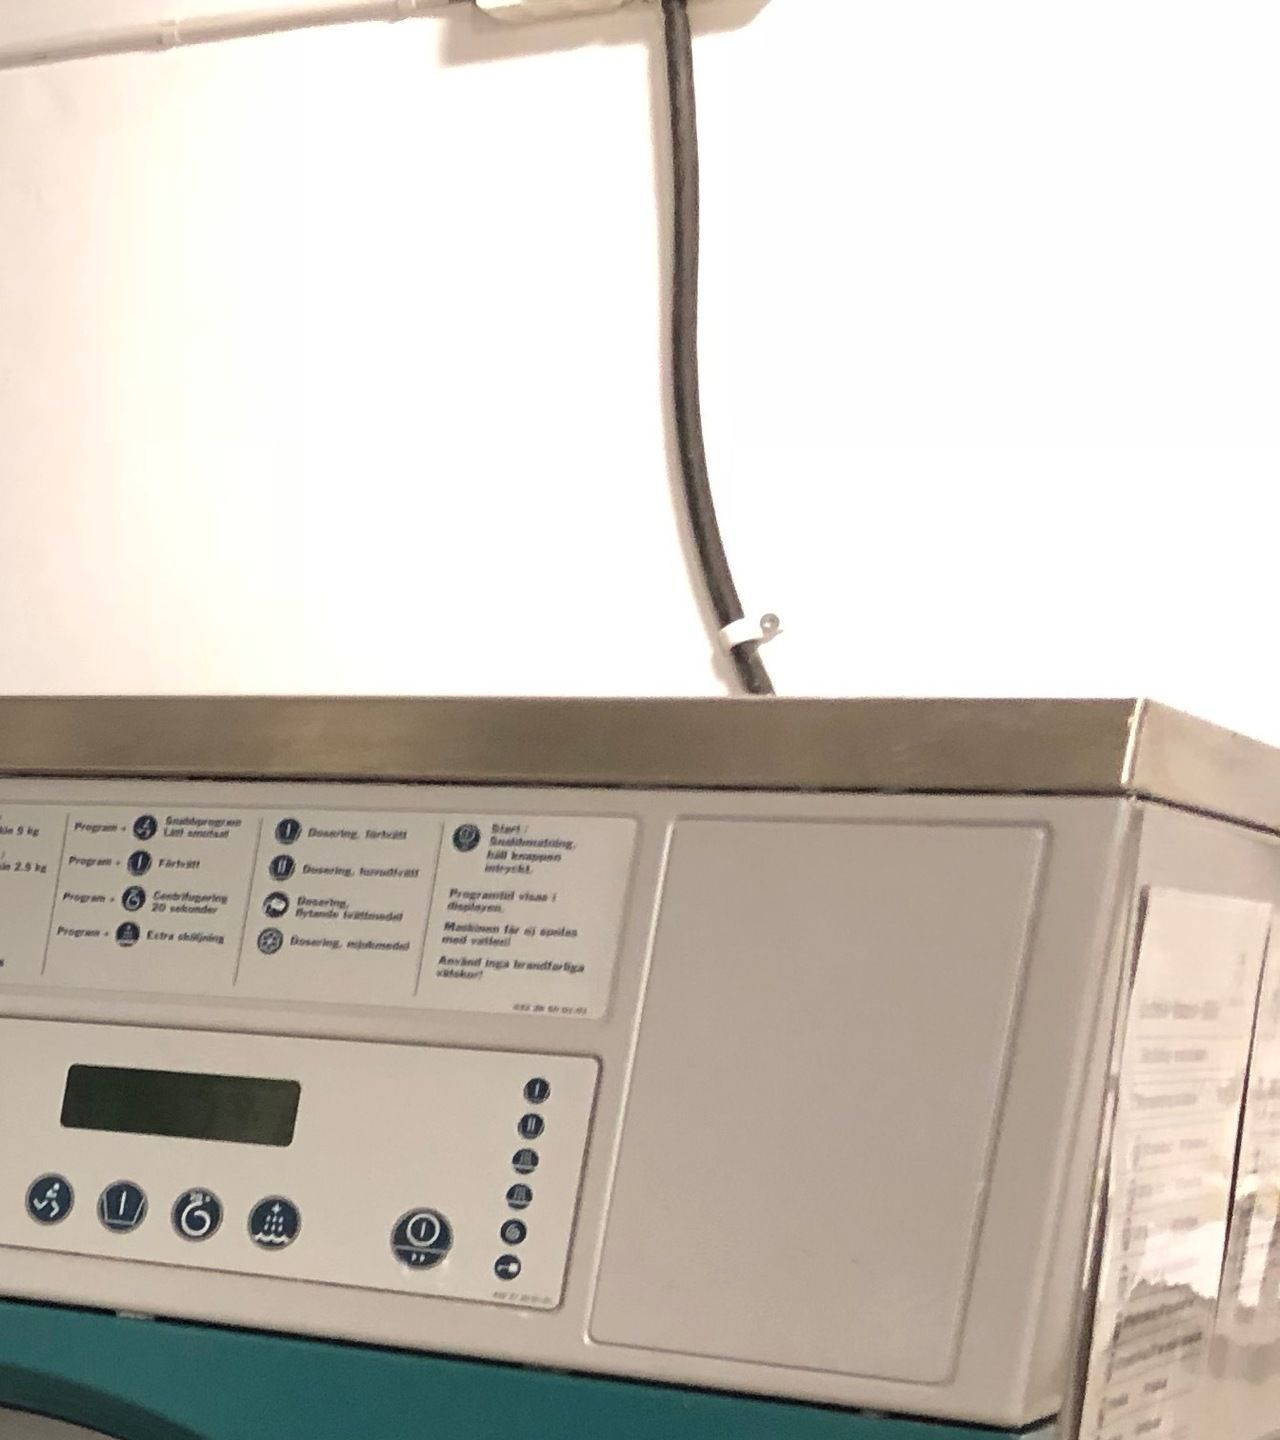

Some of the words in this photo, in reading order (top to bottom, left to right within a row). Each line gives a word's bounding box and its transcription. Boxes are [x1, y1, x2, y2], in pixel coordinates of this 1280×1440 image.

[27, 826, 40, 837] kg
[74, 822, 117, 834] Program
[68, 856, 112, 868] Program
[511, 851, 562, 862] knappen
[35, 863, 47, 874] kg
[63, 892, 106, 903] Program
[57, 926, 101, 938] Program
[444, 922, 500, 934] Maskinen
[146, 930, 174, 941] Extra
[438, 956, 482, 967] Använd
